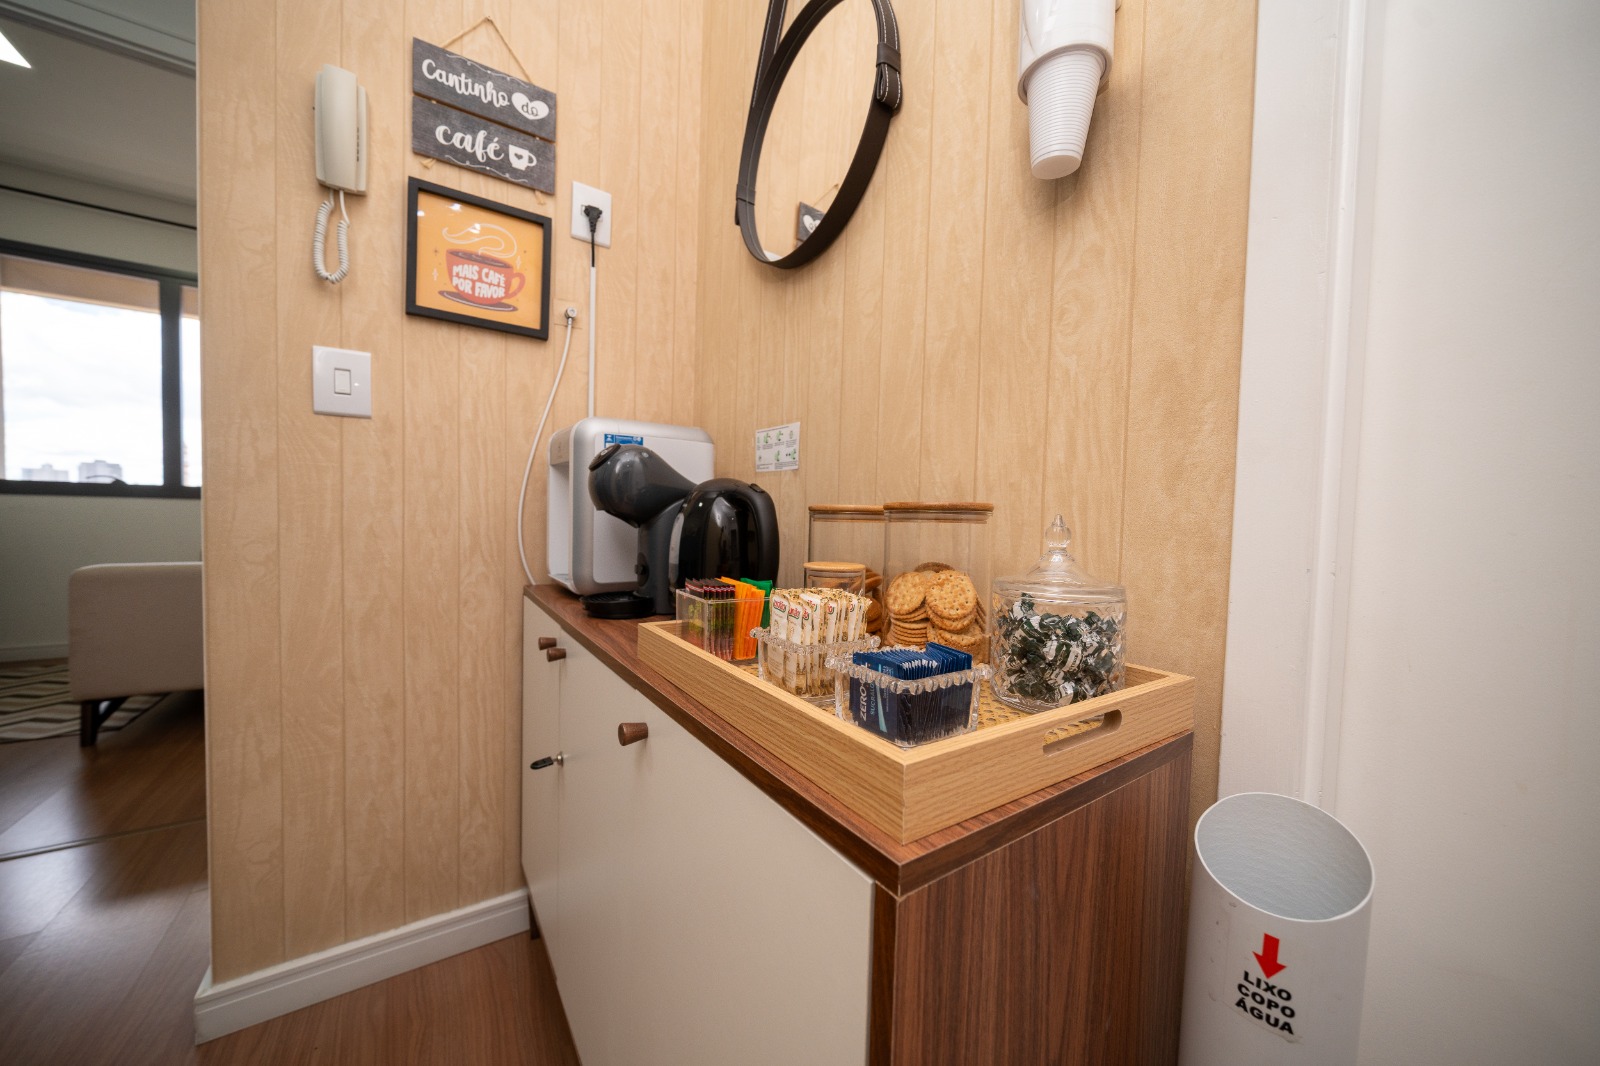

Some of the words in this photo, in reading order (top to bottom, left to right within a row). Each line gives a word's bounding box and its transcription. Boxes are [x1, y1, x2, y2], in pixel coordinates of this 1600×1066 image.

[422, 59, 510, 108] Cantinho
[521, 102, 539, 117] do
[435, 125, 504, 163] café
[451, 276, 473, 295] POR
[474, 281, 506, 299] FAVOR
[452, 263, 480, 281] MAIS
[481, 267, 506, 288] CAFÉ
[1237, 983, 1296, 1019] COPO
[1243, 970, 1292, 1002] LIXO
[1235, 997, 1294, 1035] ÁGUA
